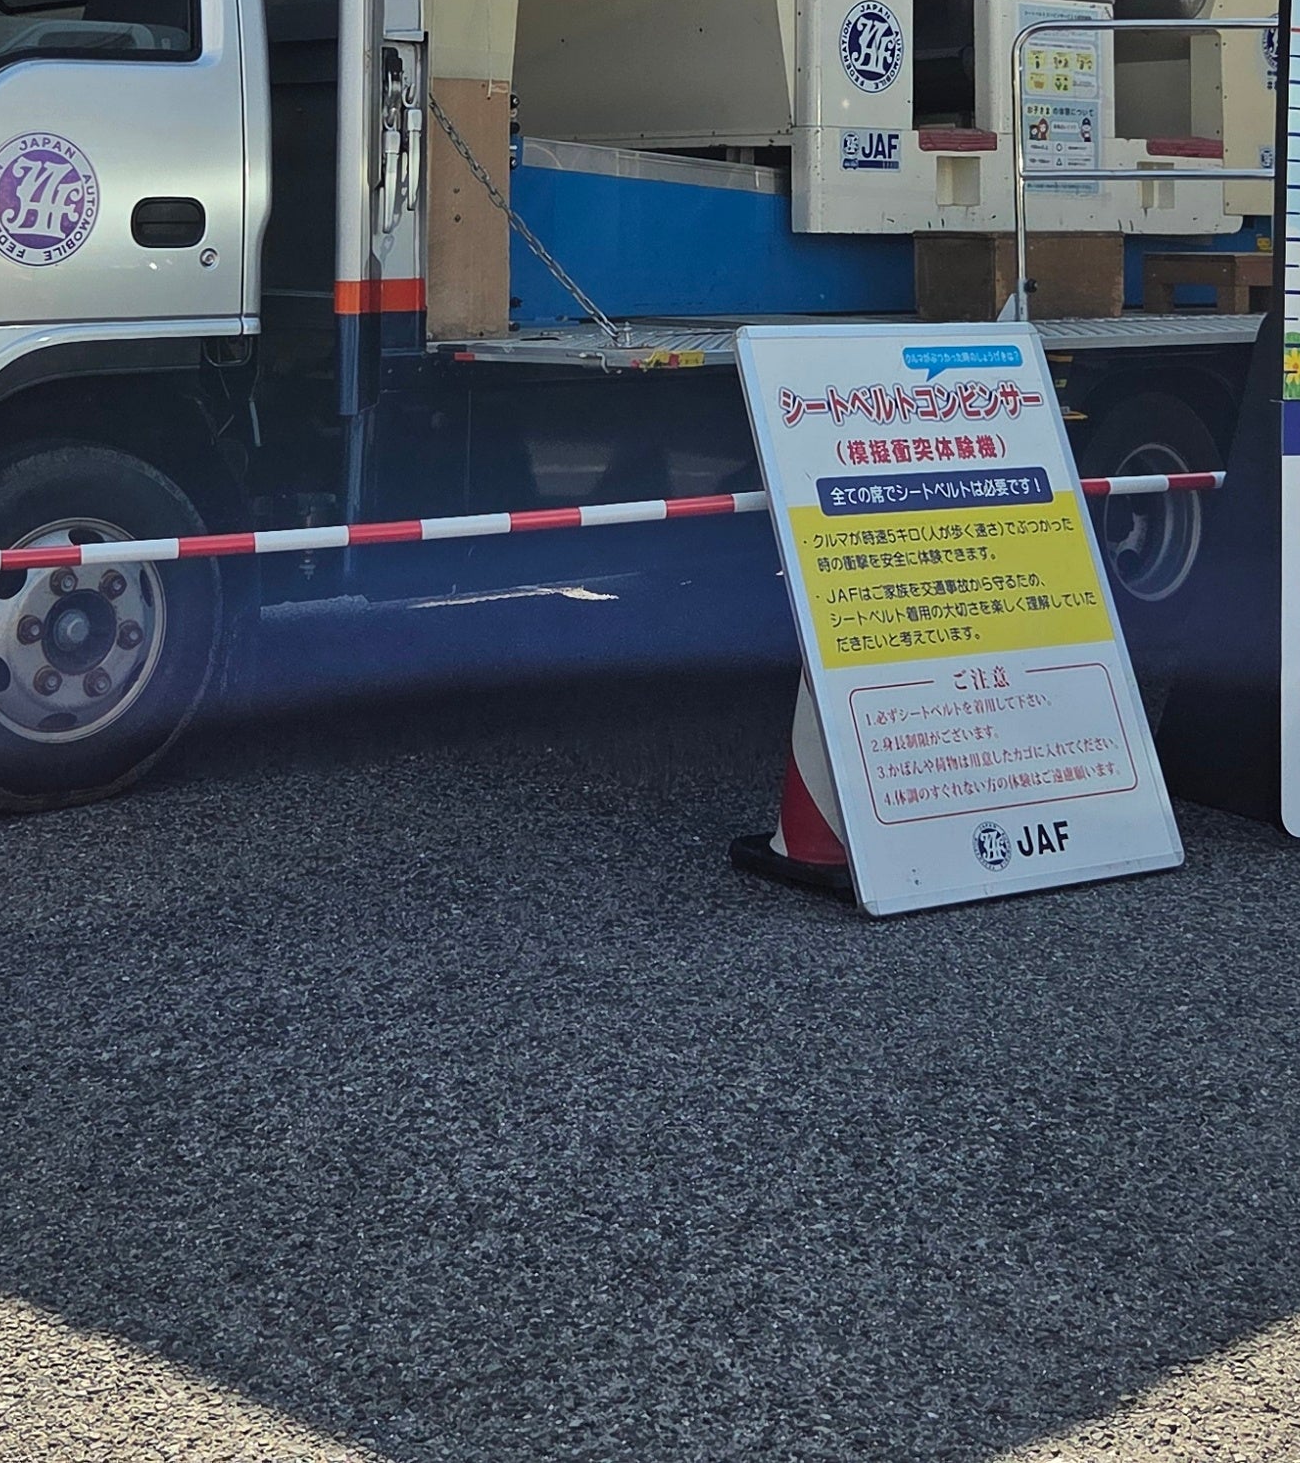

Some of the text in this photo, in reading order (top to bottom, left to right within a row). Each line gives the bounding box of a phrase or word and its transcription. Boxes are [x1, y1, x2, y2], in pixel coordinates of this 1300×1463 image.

[860, 4, 891, 20] JAPAN
[18, 137, 76, 160] JAPAN
[861, 132, 900, 159] JAF
[43, 173, 96, 262] AUTOMOBILE
[779, 383, 1044, 426] シートベルトコンビンサー
[836, 433, 1008, 466] （模擬衝突体験機）
[829, 476, 1042, 507] 全ての席でシートベルトは必要です！
[816, 545, 998, 574] 時の衝撃を安全に体験できます。
[829, 591, 1098, 629] シートベルト着用の大切さを楽しく理解していた
[836, 625, 982, 654] だきたいと考えています。
[952, 665, 1011, 691] ご注意
[1016, 820, 1070, 858] JAF
